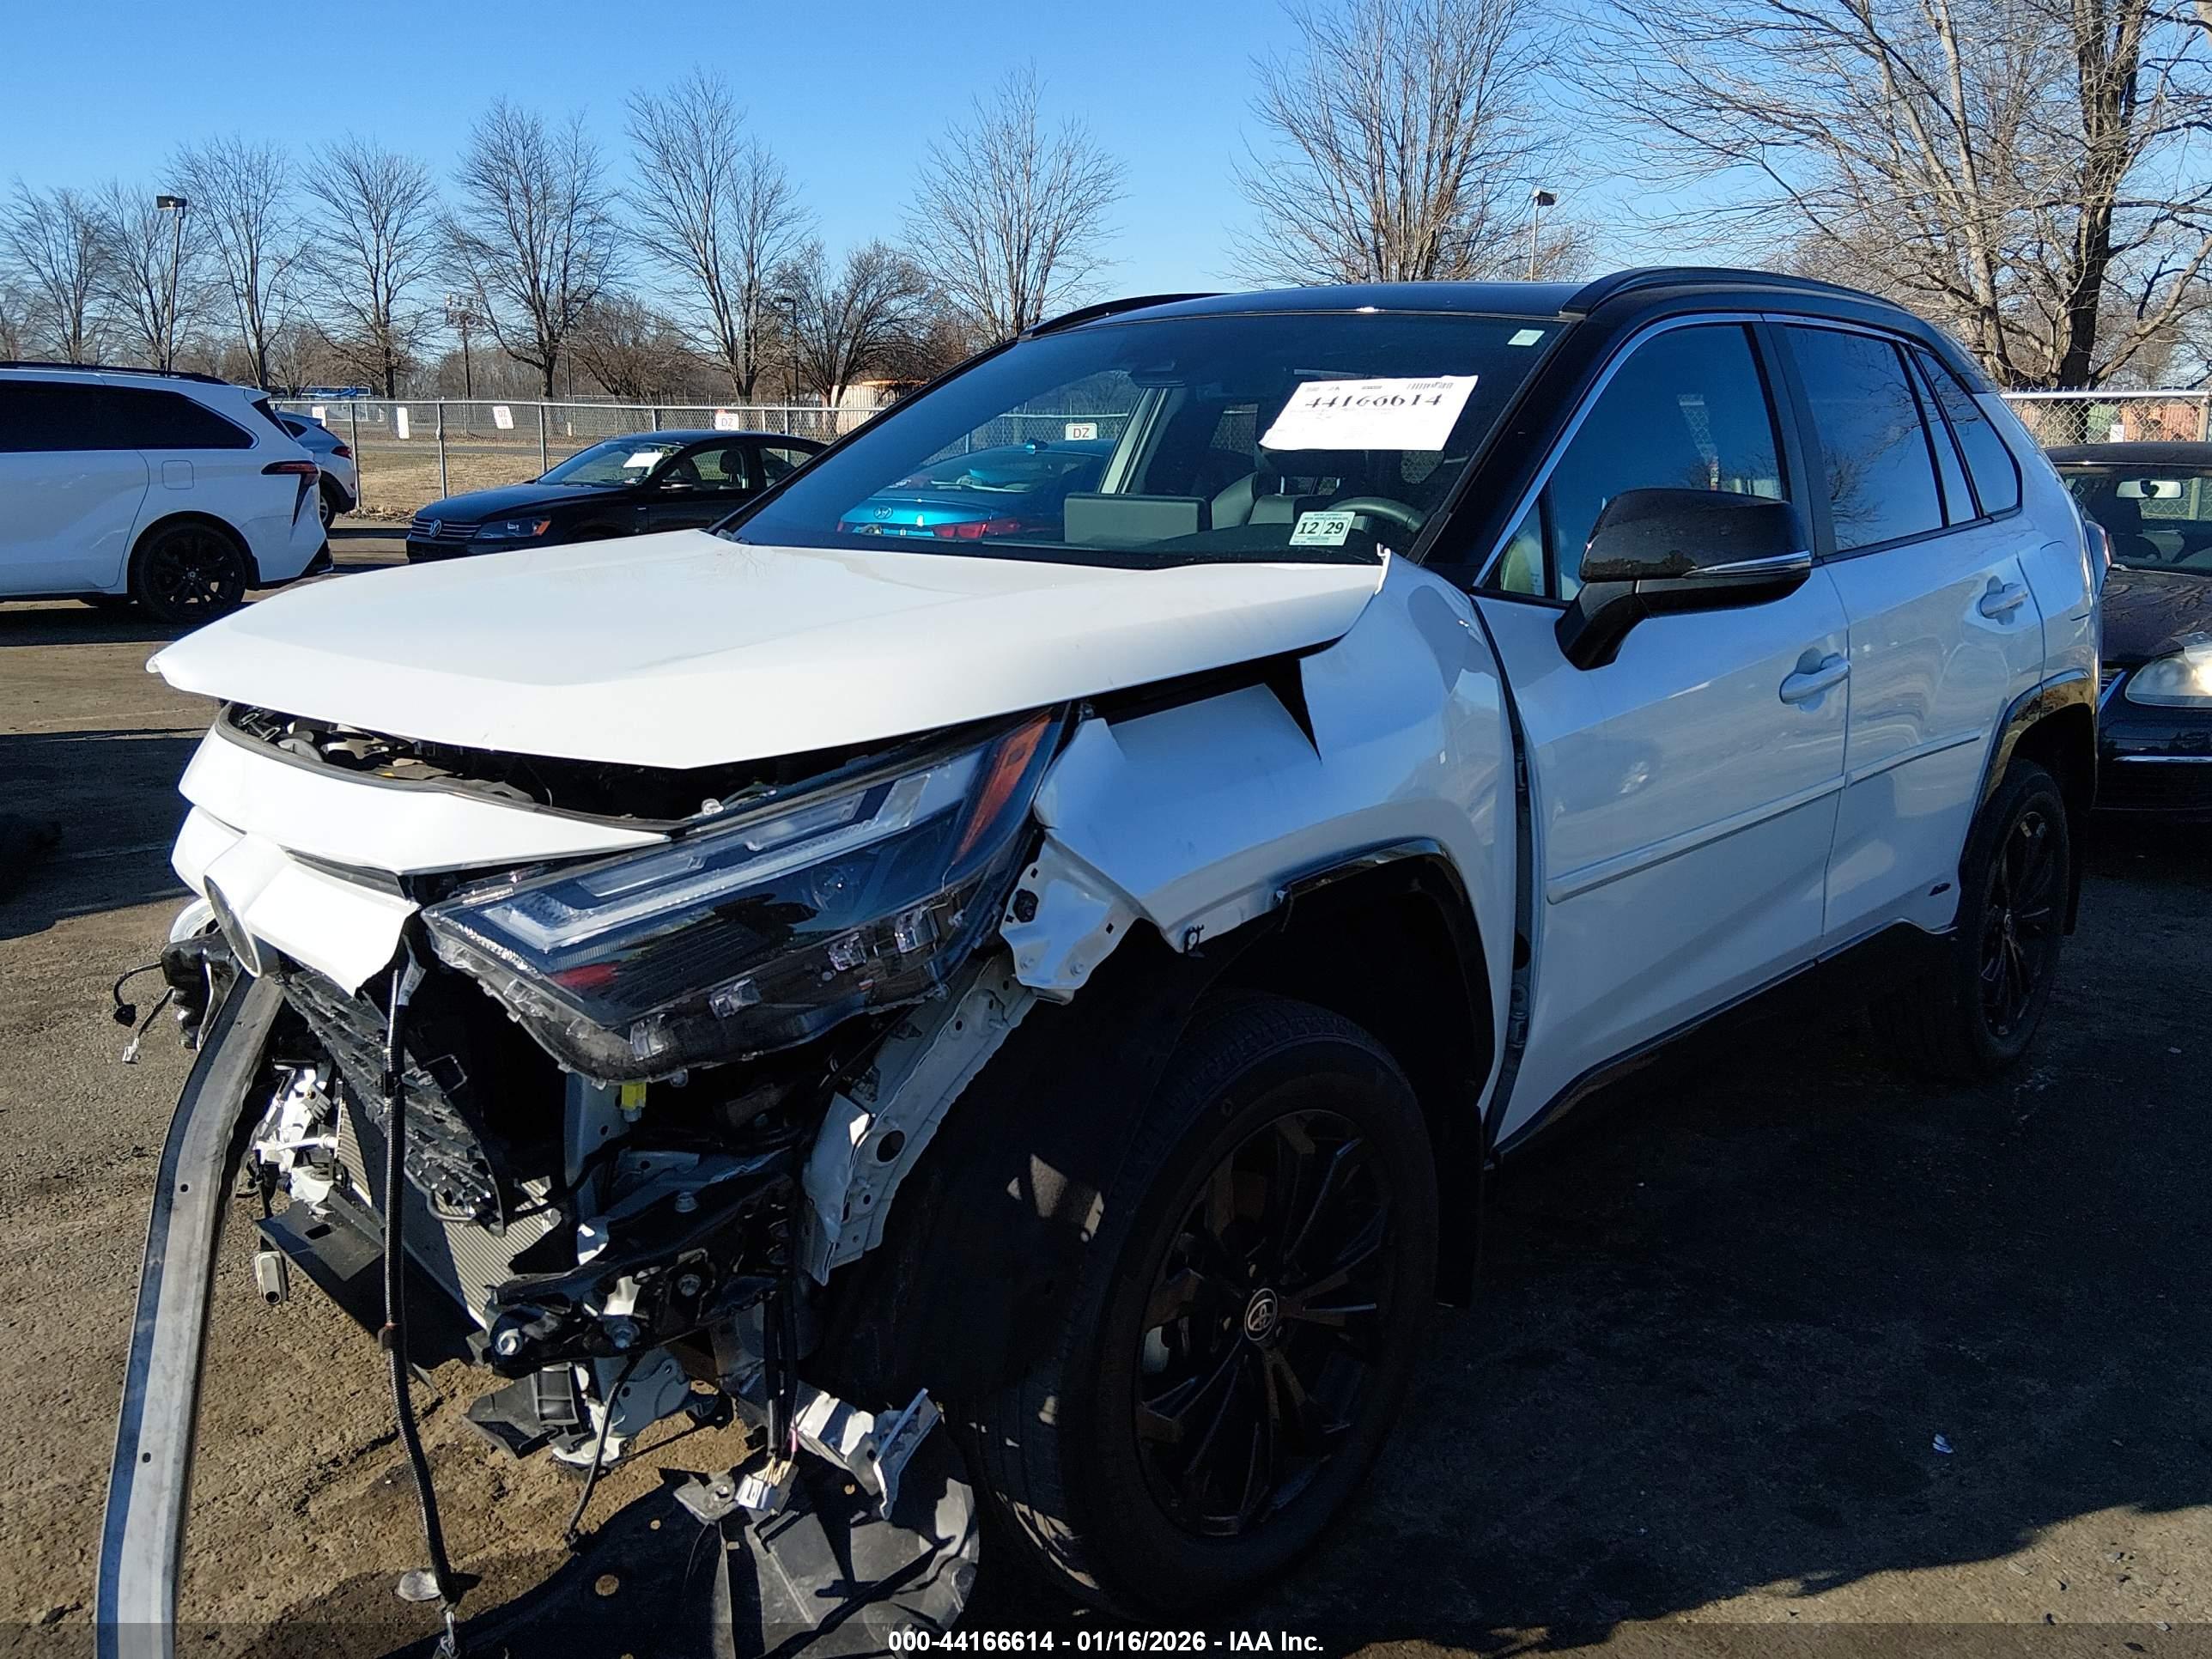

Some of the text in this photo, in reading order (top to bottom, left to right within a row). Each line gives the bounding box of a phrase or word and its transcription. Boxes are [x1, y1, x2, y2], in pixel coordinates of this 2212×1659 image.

[721, 417, 734, 427] DZ
[1073, 428, 1090, 438] DZ
[1298, 522, 1344, 534] 12 29
